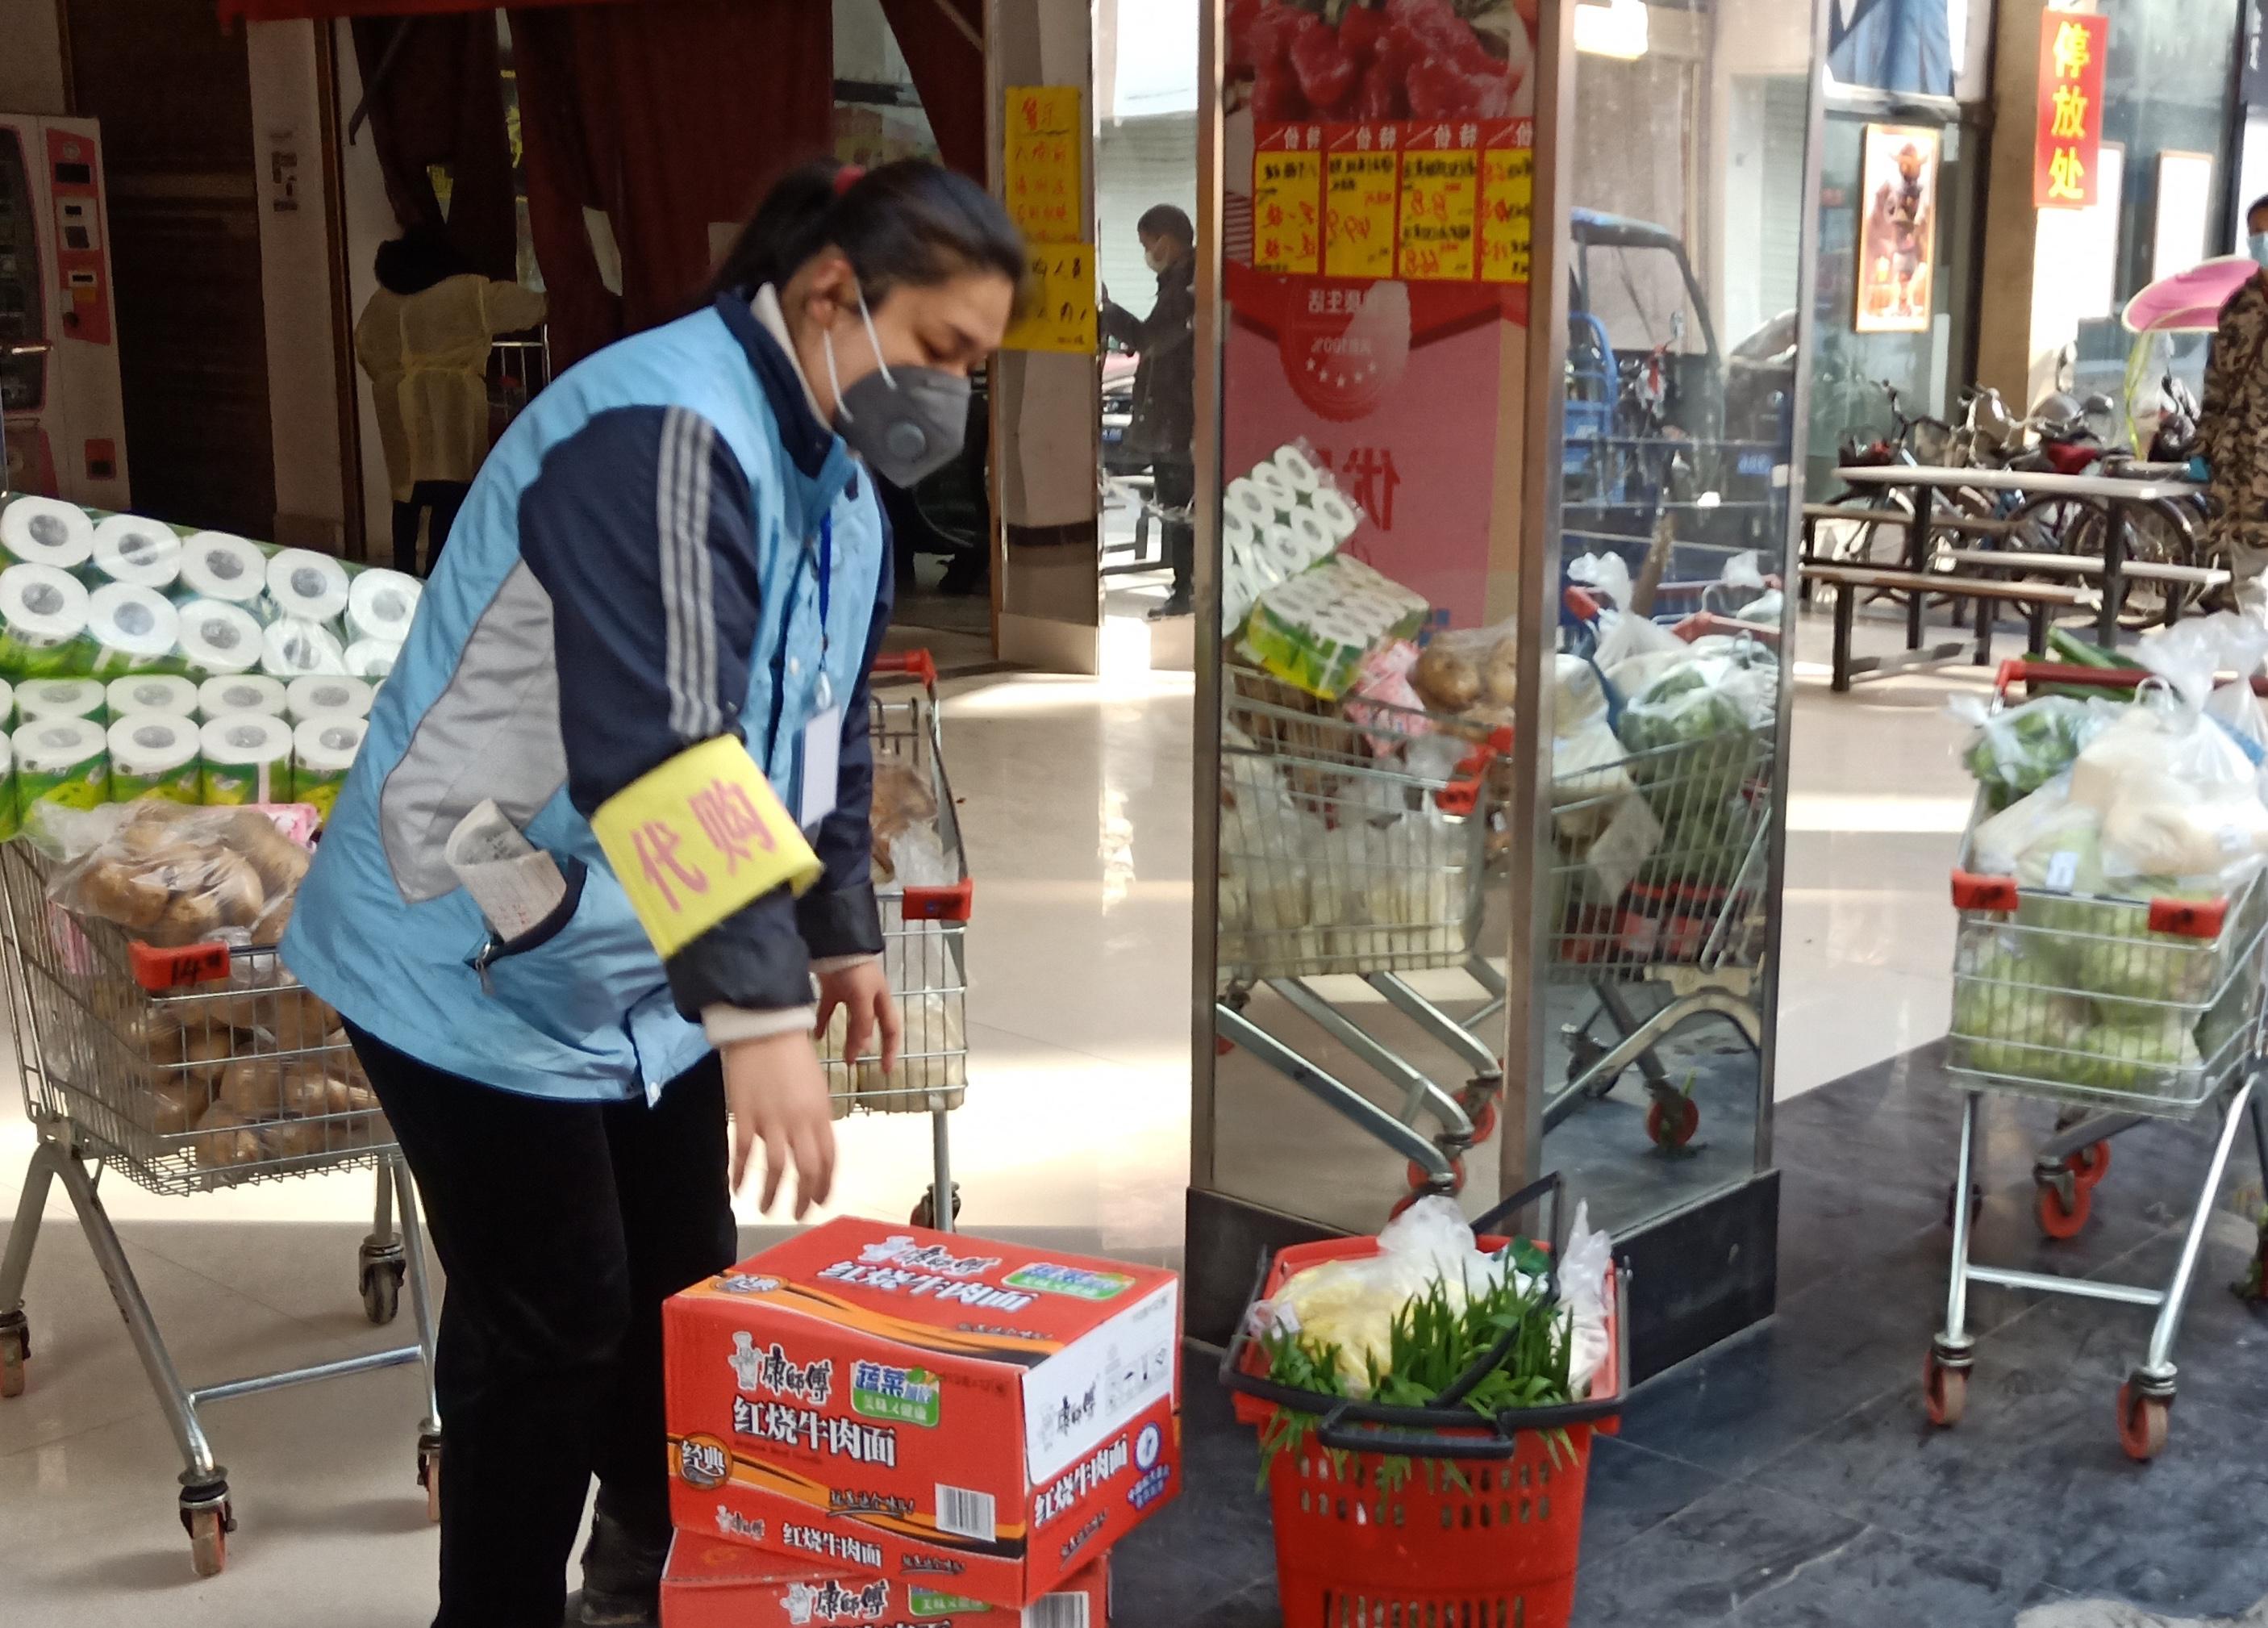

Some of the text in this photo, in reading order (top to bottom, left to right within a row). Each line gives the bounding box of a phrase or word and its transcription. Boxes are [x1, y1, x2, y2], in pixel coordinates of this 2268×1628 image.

[2049, 20, 2091, 200] 停放处
[630, 779, 774, 913] 代购
[818, 1261, 1040, 1313] 红烧牛肉面
[682, 1440, 725, 1476] 经典
[733, 1396, 896, 1467] 红烧牛肉面
[1034, 1433, 1128, 1529] 红烧牛肉面
[783, 1522, 882, 1567] 红烧牛肉面
